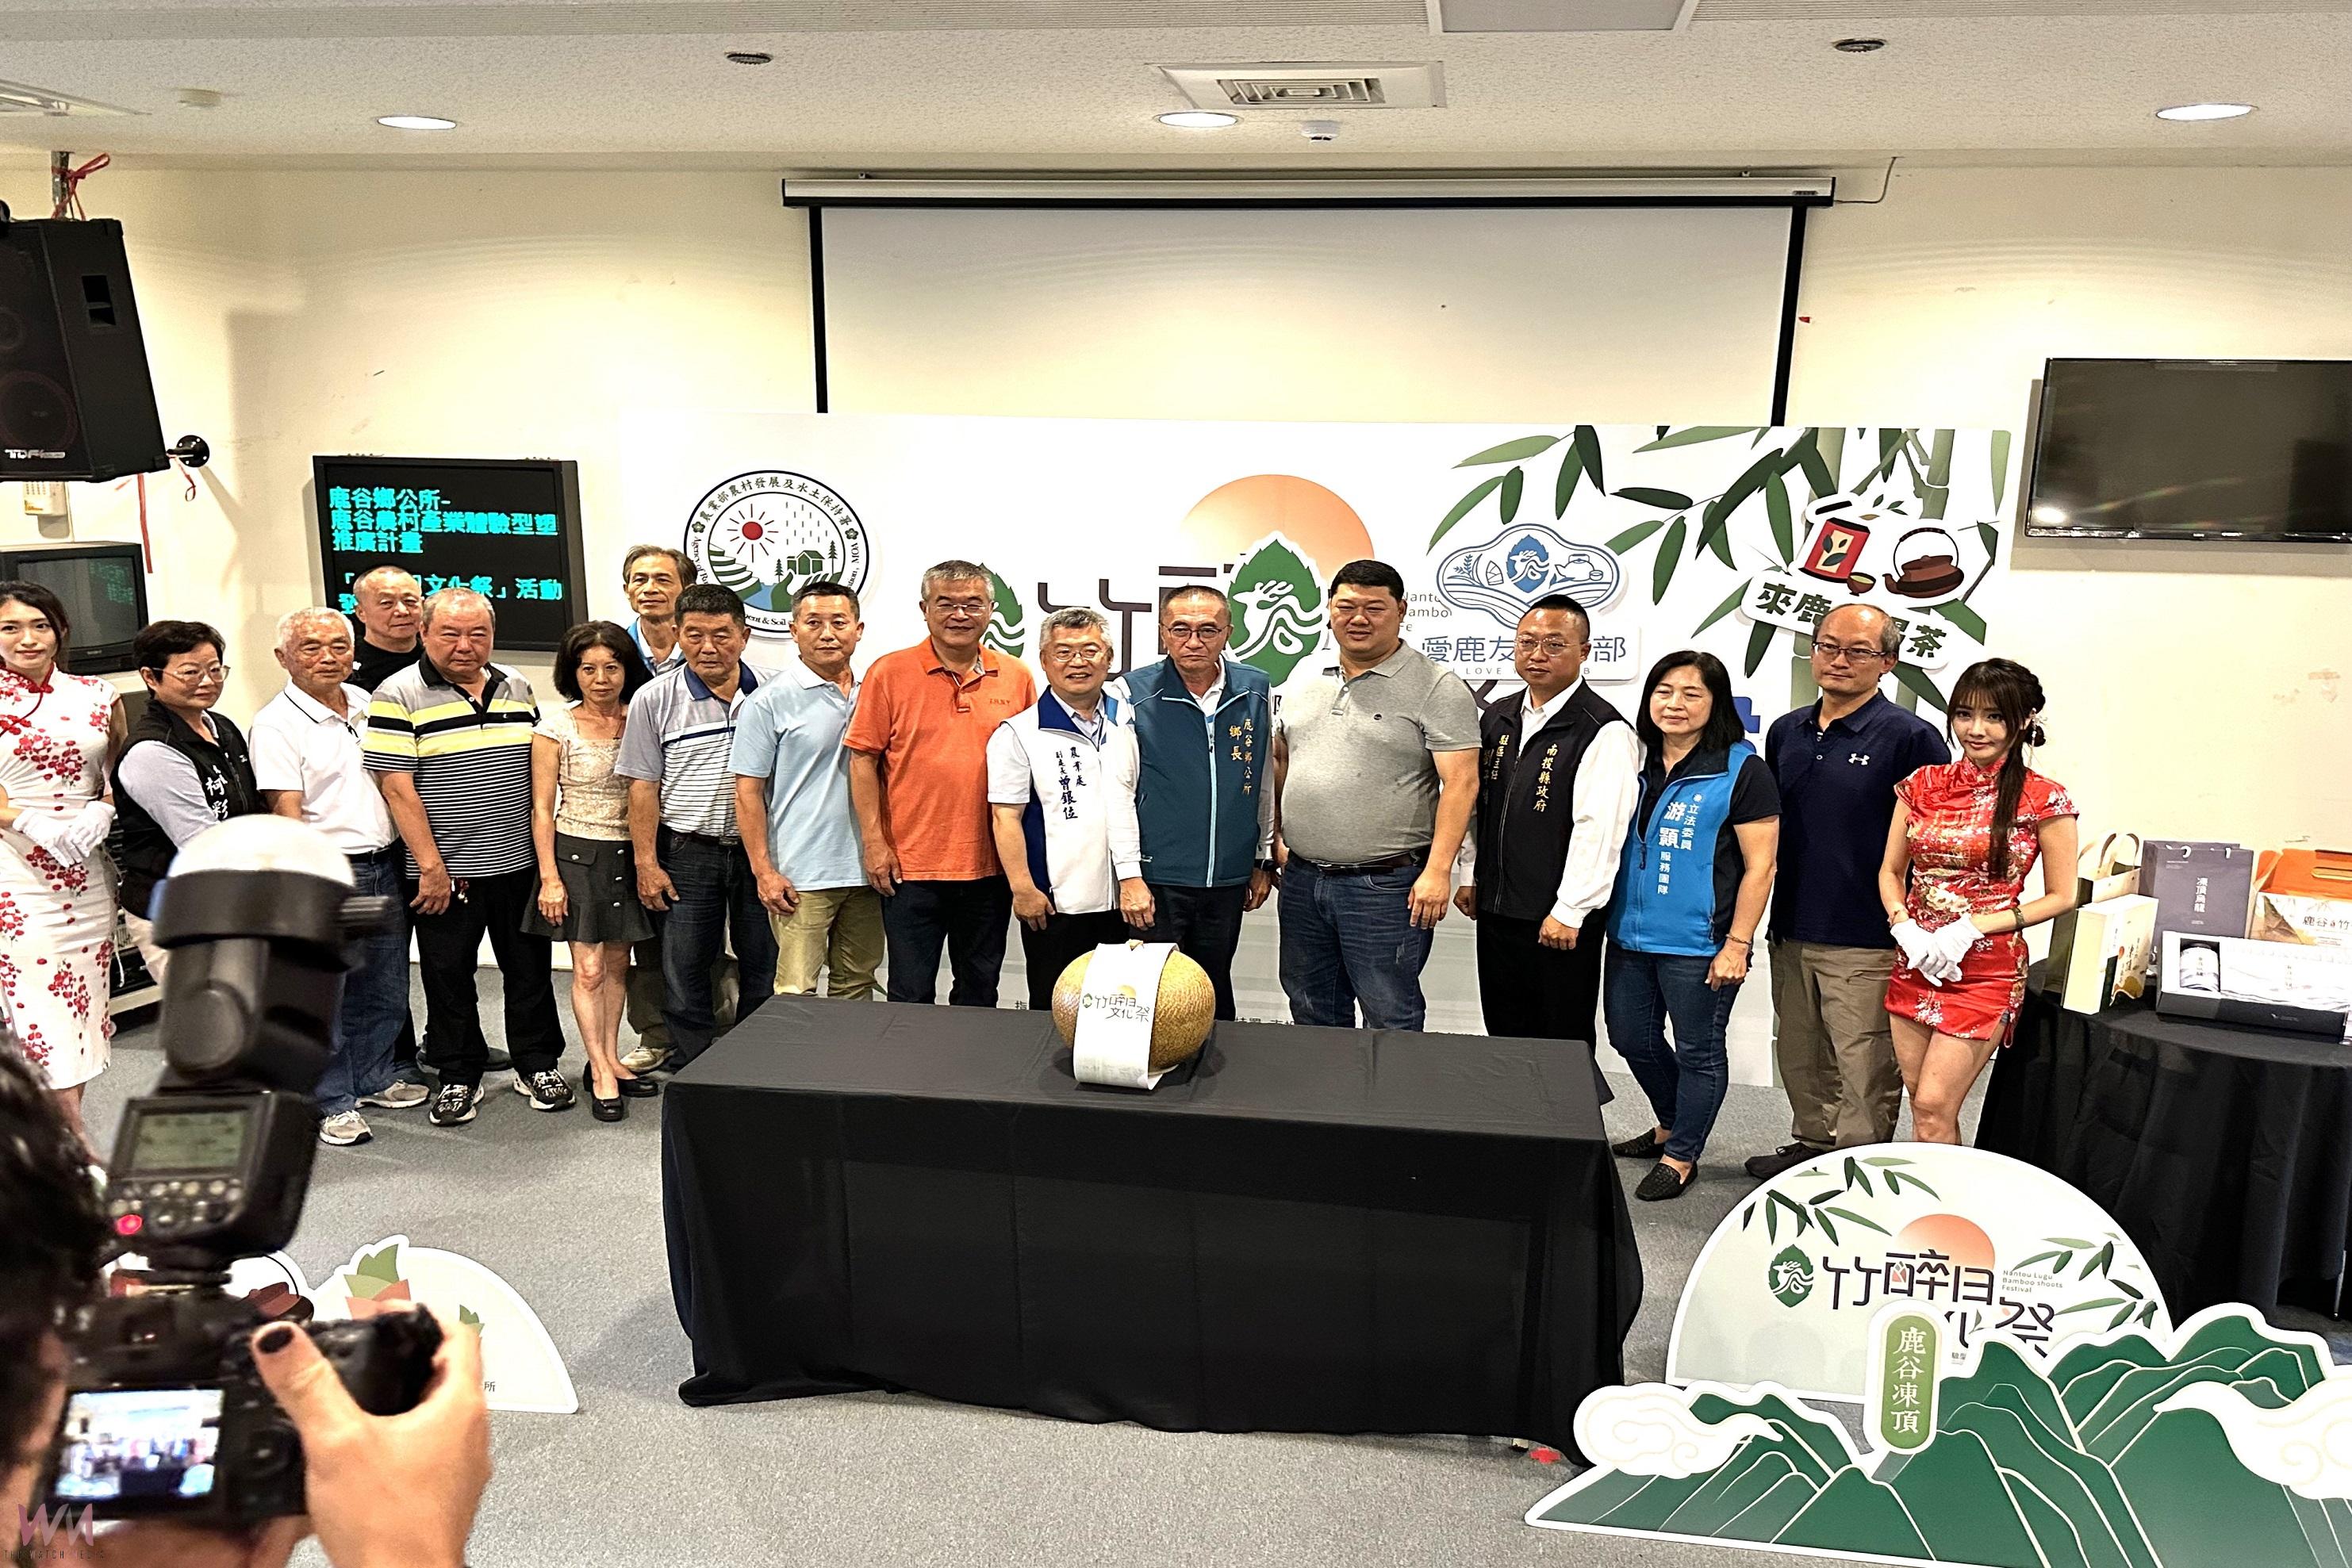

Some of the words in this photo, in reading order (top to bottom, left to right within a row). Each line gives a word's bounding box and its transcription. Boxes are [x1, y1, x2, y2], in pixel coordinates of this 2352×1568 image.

[700, 476, 853, 526] 農業部農村發展及水土保持署
[332, 530, 424, 554] 推廣計畫
[770, 618, 786, 627] Soil
[1755, 582, 1947, 658] 來鹿茶
[1422, 635, 1627, 663] 愛鹿友部
[1229, 725, 1243, 761] 鄉長
[1533, 743, 1558, 812] 南投縣政府
[1680, 803, 1700, 850] 立法委員
[1657, 851, 1671, 895] 服務團隊
[2001, 1284, 2032, 1293] Festival
[2002, 1277, 2035, 1286] Bamboo
[2034, 1271, 2053, 1281] Lugu
[1890, 1326, 1927, 1434] 鹿谷凍頂
